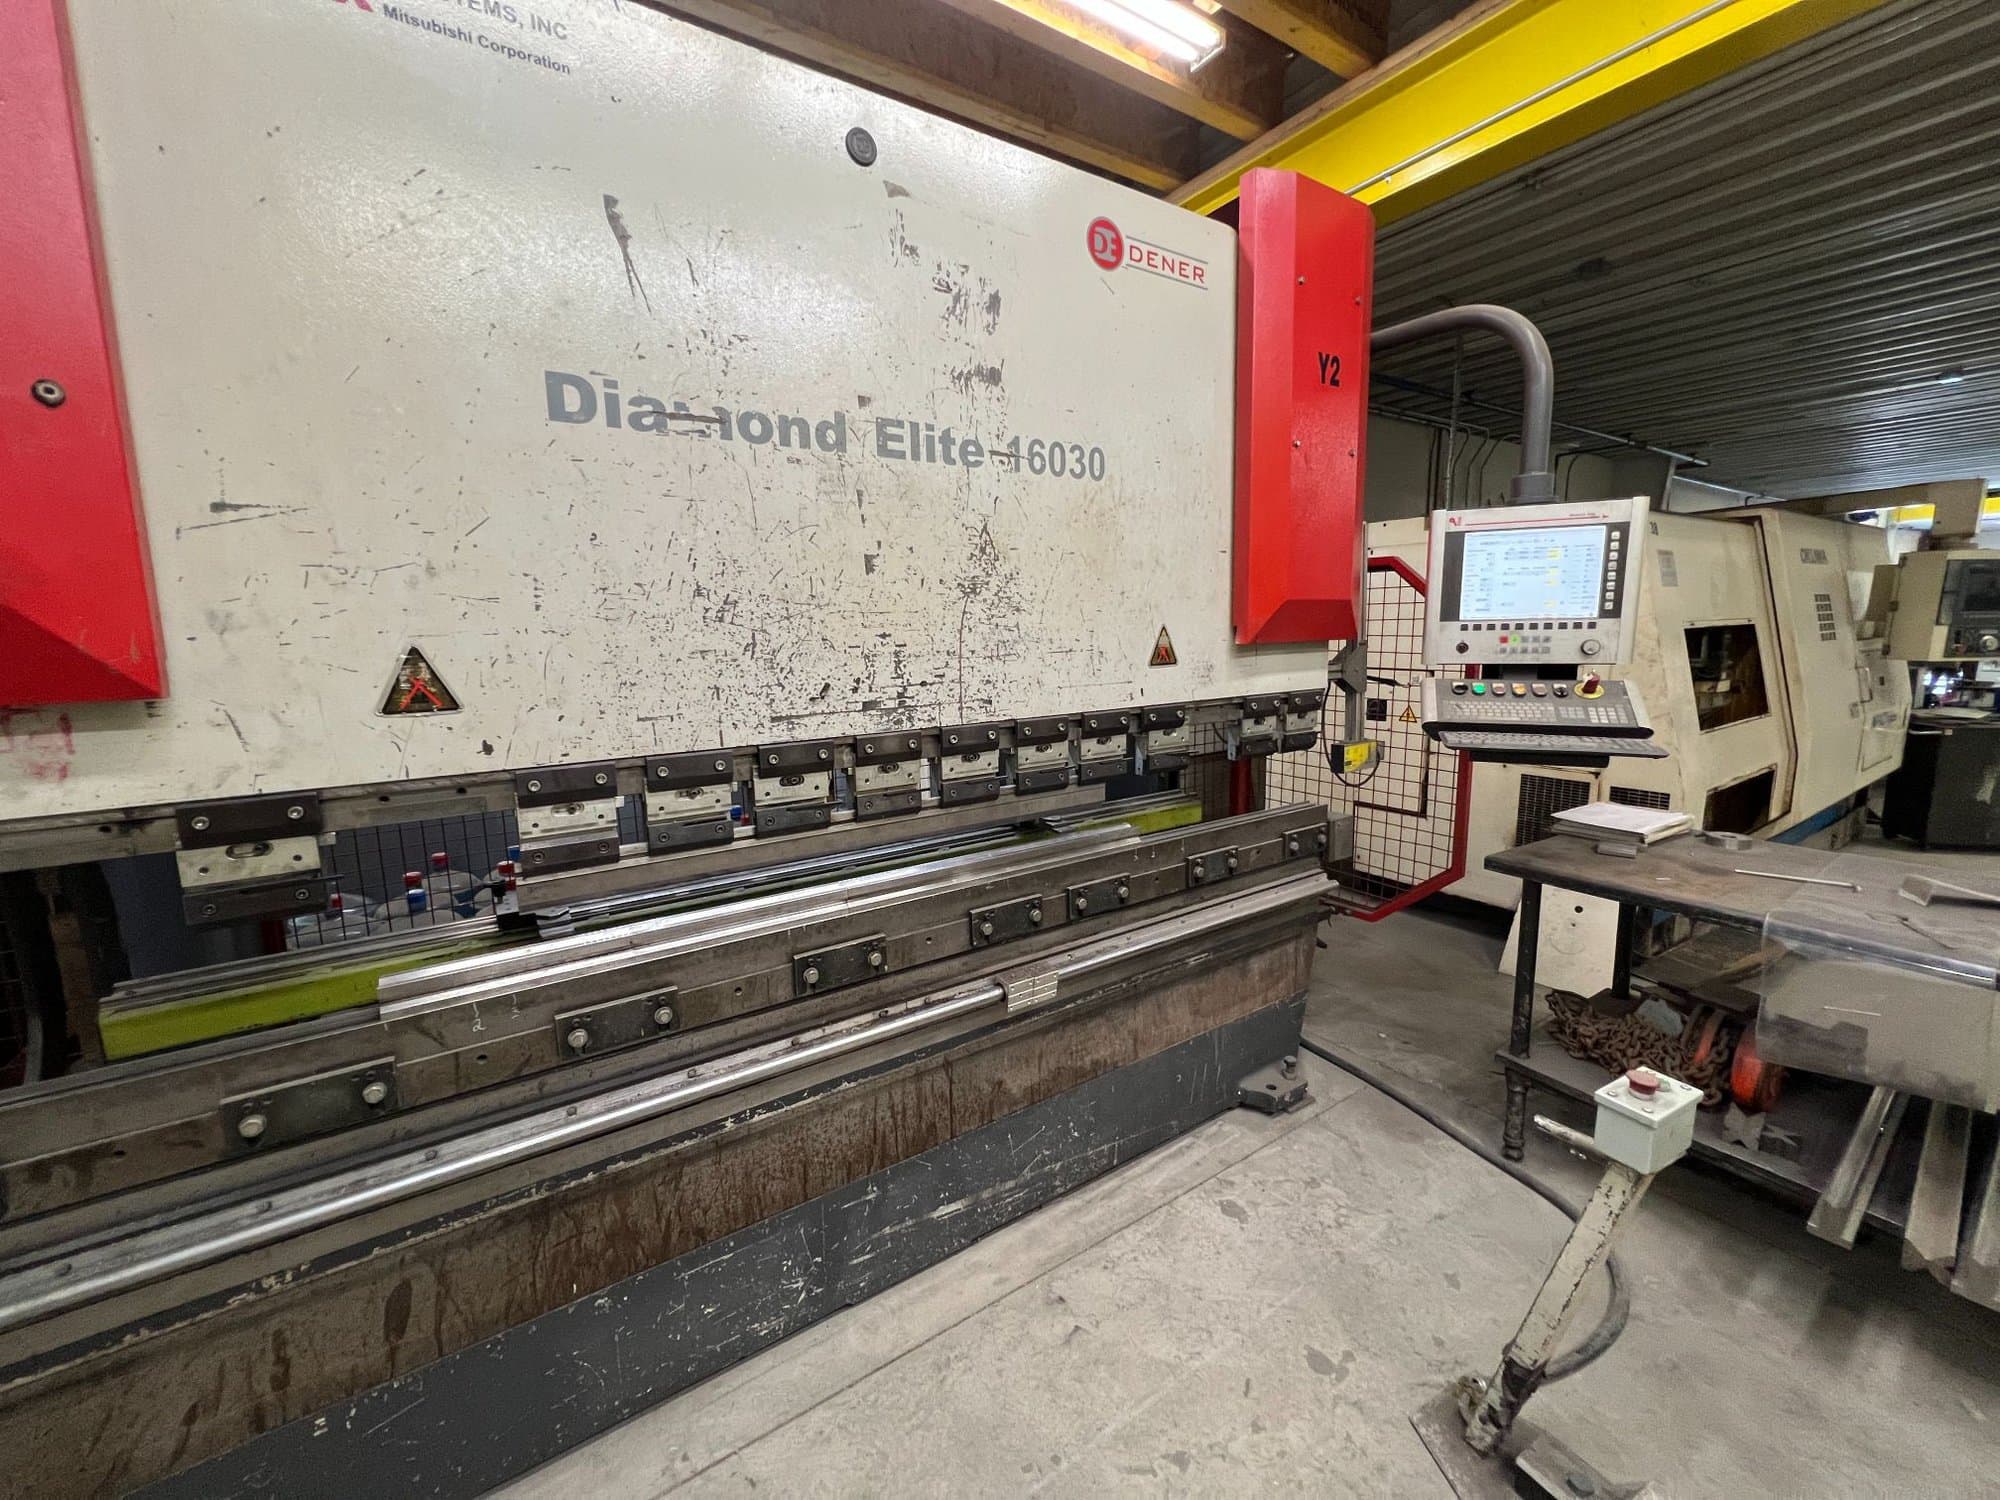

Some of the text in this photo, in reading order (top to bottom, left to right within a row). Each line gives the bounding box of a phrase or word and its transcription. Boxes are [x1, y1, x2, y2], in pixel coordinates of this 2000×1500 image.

[382, 3, 571, 75] Mitsubishi Corporation
[442, 0, 568, 40] EMS, INC
[1129, 244, 1206, 284] DENER
[1318, 351, 1341, 388] Y2
[875, 416, 985, 468] Elite
[1006, 435, 1106, 482] 16030
